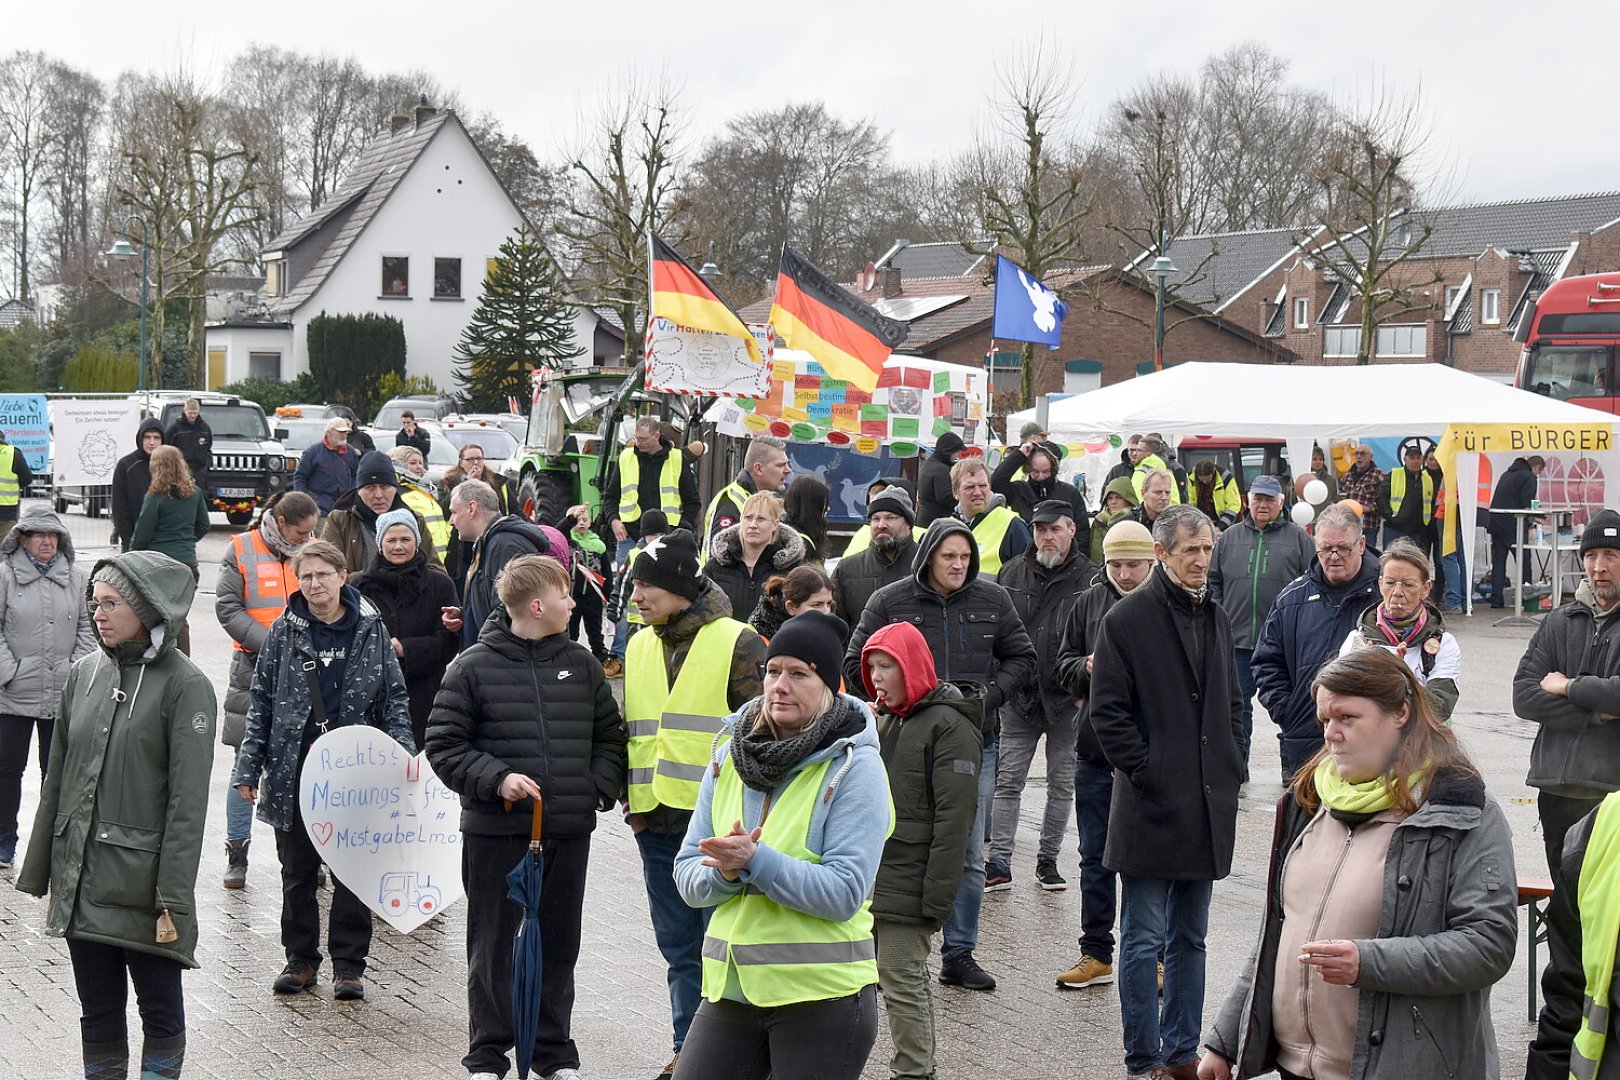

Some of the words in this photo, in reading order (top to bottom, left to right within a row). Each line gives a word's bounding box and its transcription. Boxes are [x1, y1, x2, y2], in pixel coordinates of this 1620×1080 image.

[795, 391, 868, 403] Selbstbestimmung
[807, 405, 854, 415] Demokratie
[1454, 430, 1491, 451] ür
[1511, 425, 1609, 450] BÜRGER
[320, 741, 399, 772] Rechts?
[311, 780, 400, 811] Meinungs
